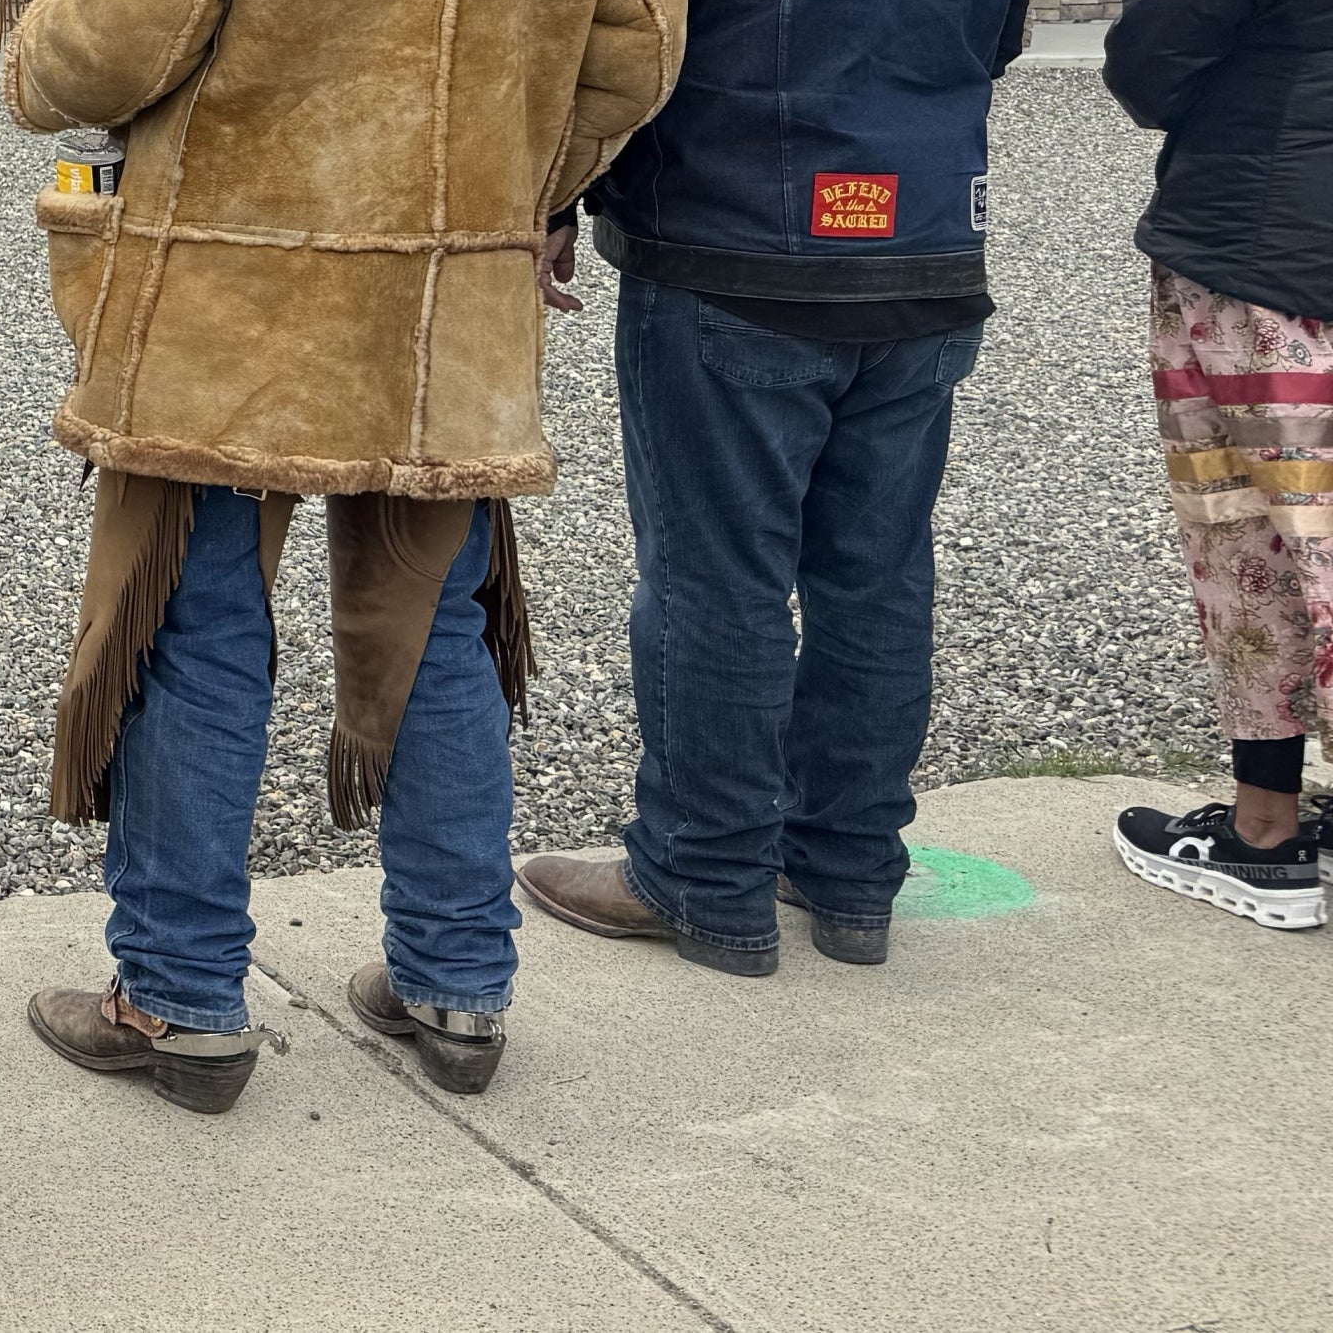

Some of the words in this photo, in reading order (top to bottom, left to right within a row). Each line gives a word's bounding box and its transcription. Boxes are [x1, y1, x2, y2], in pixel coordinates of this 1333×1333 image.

[819, 181, 892, 204] DEFEND
[846, 198, 866, 211] the
[819, 213, 888, 229] SACRED
